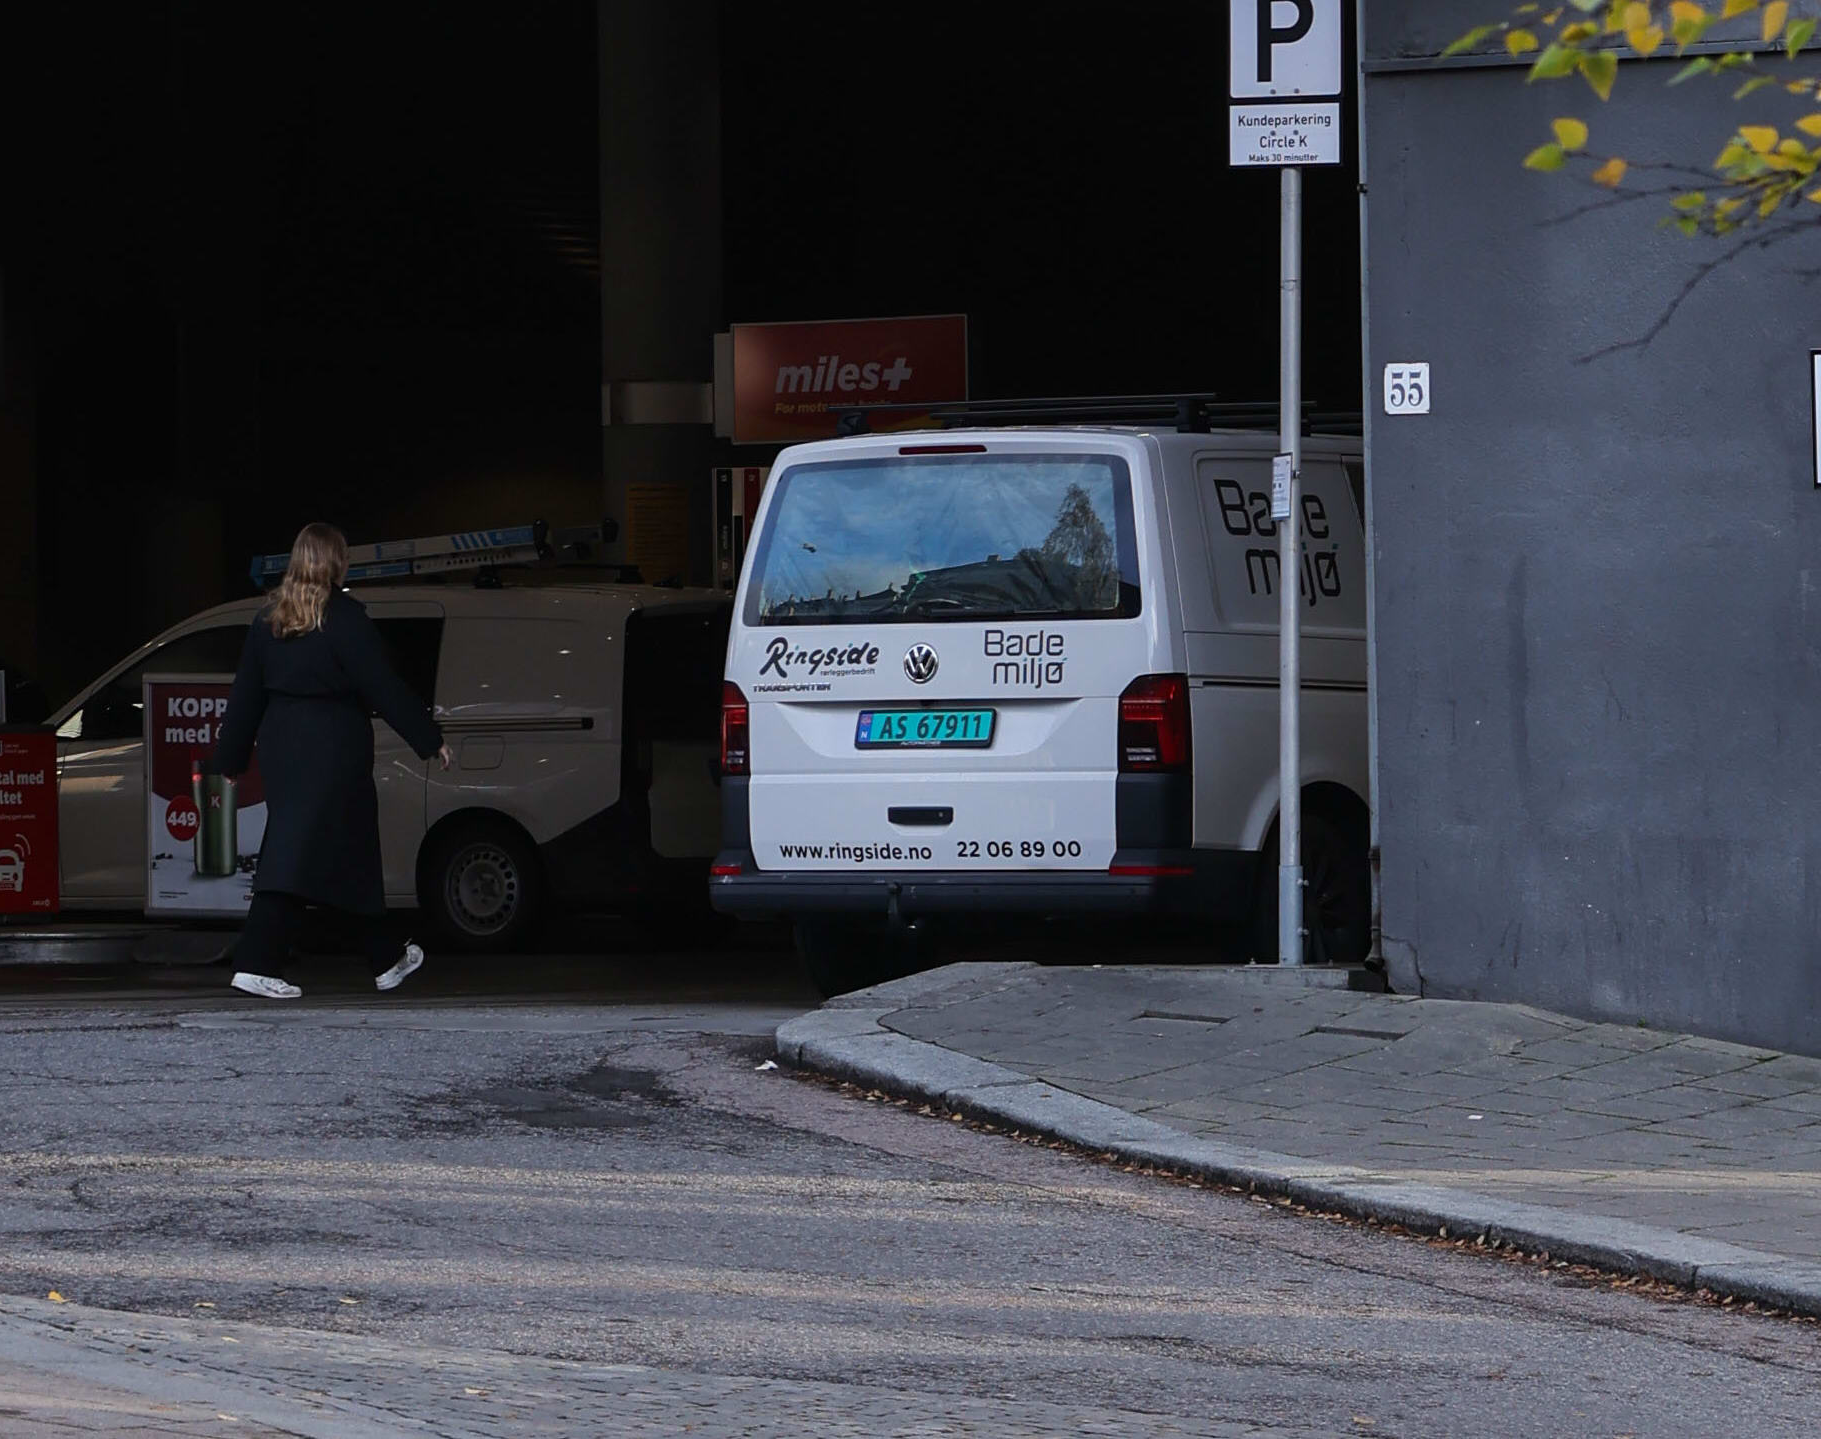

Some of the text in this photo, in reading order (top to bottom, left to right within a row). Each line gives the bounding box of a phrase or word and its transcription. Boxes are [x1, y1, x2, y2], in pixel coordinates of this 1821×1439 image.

[1237, 113, 1332, 129] Kundeparkering
[1259, 135, 1308, 149] Circle K
[1248, 152, 1319, 163] Maks 30 minutter
[774, 355, 913, 394] miles+
[1390, 372, 1424, 408] 55
[774, 403, 795, 415] For
[1213, 479, 1330, 539] Bae
[984, 630, 1064, 657] Bade
[759, 636, 880, 679] Ringside
[992, 657, 1068, 689] miljø
[167, 696, 229, 718] KOPP
[165, 723, 210, 744] med
[879, 714, 983, 740] AS 67911
[17, 768, 45, 785] med
[779, 840, 1083, 863] www.ringside.no 22 06 89 00
